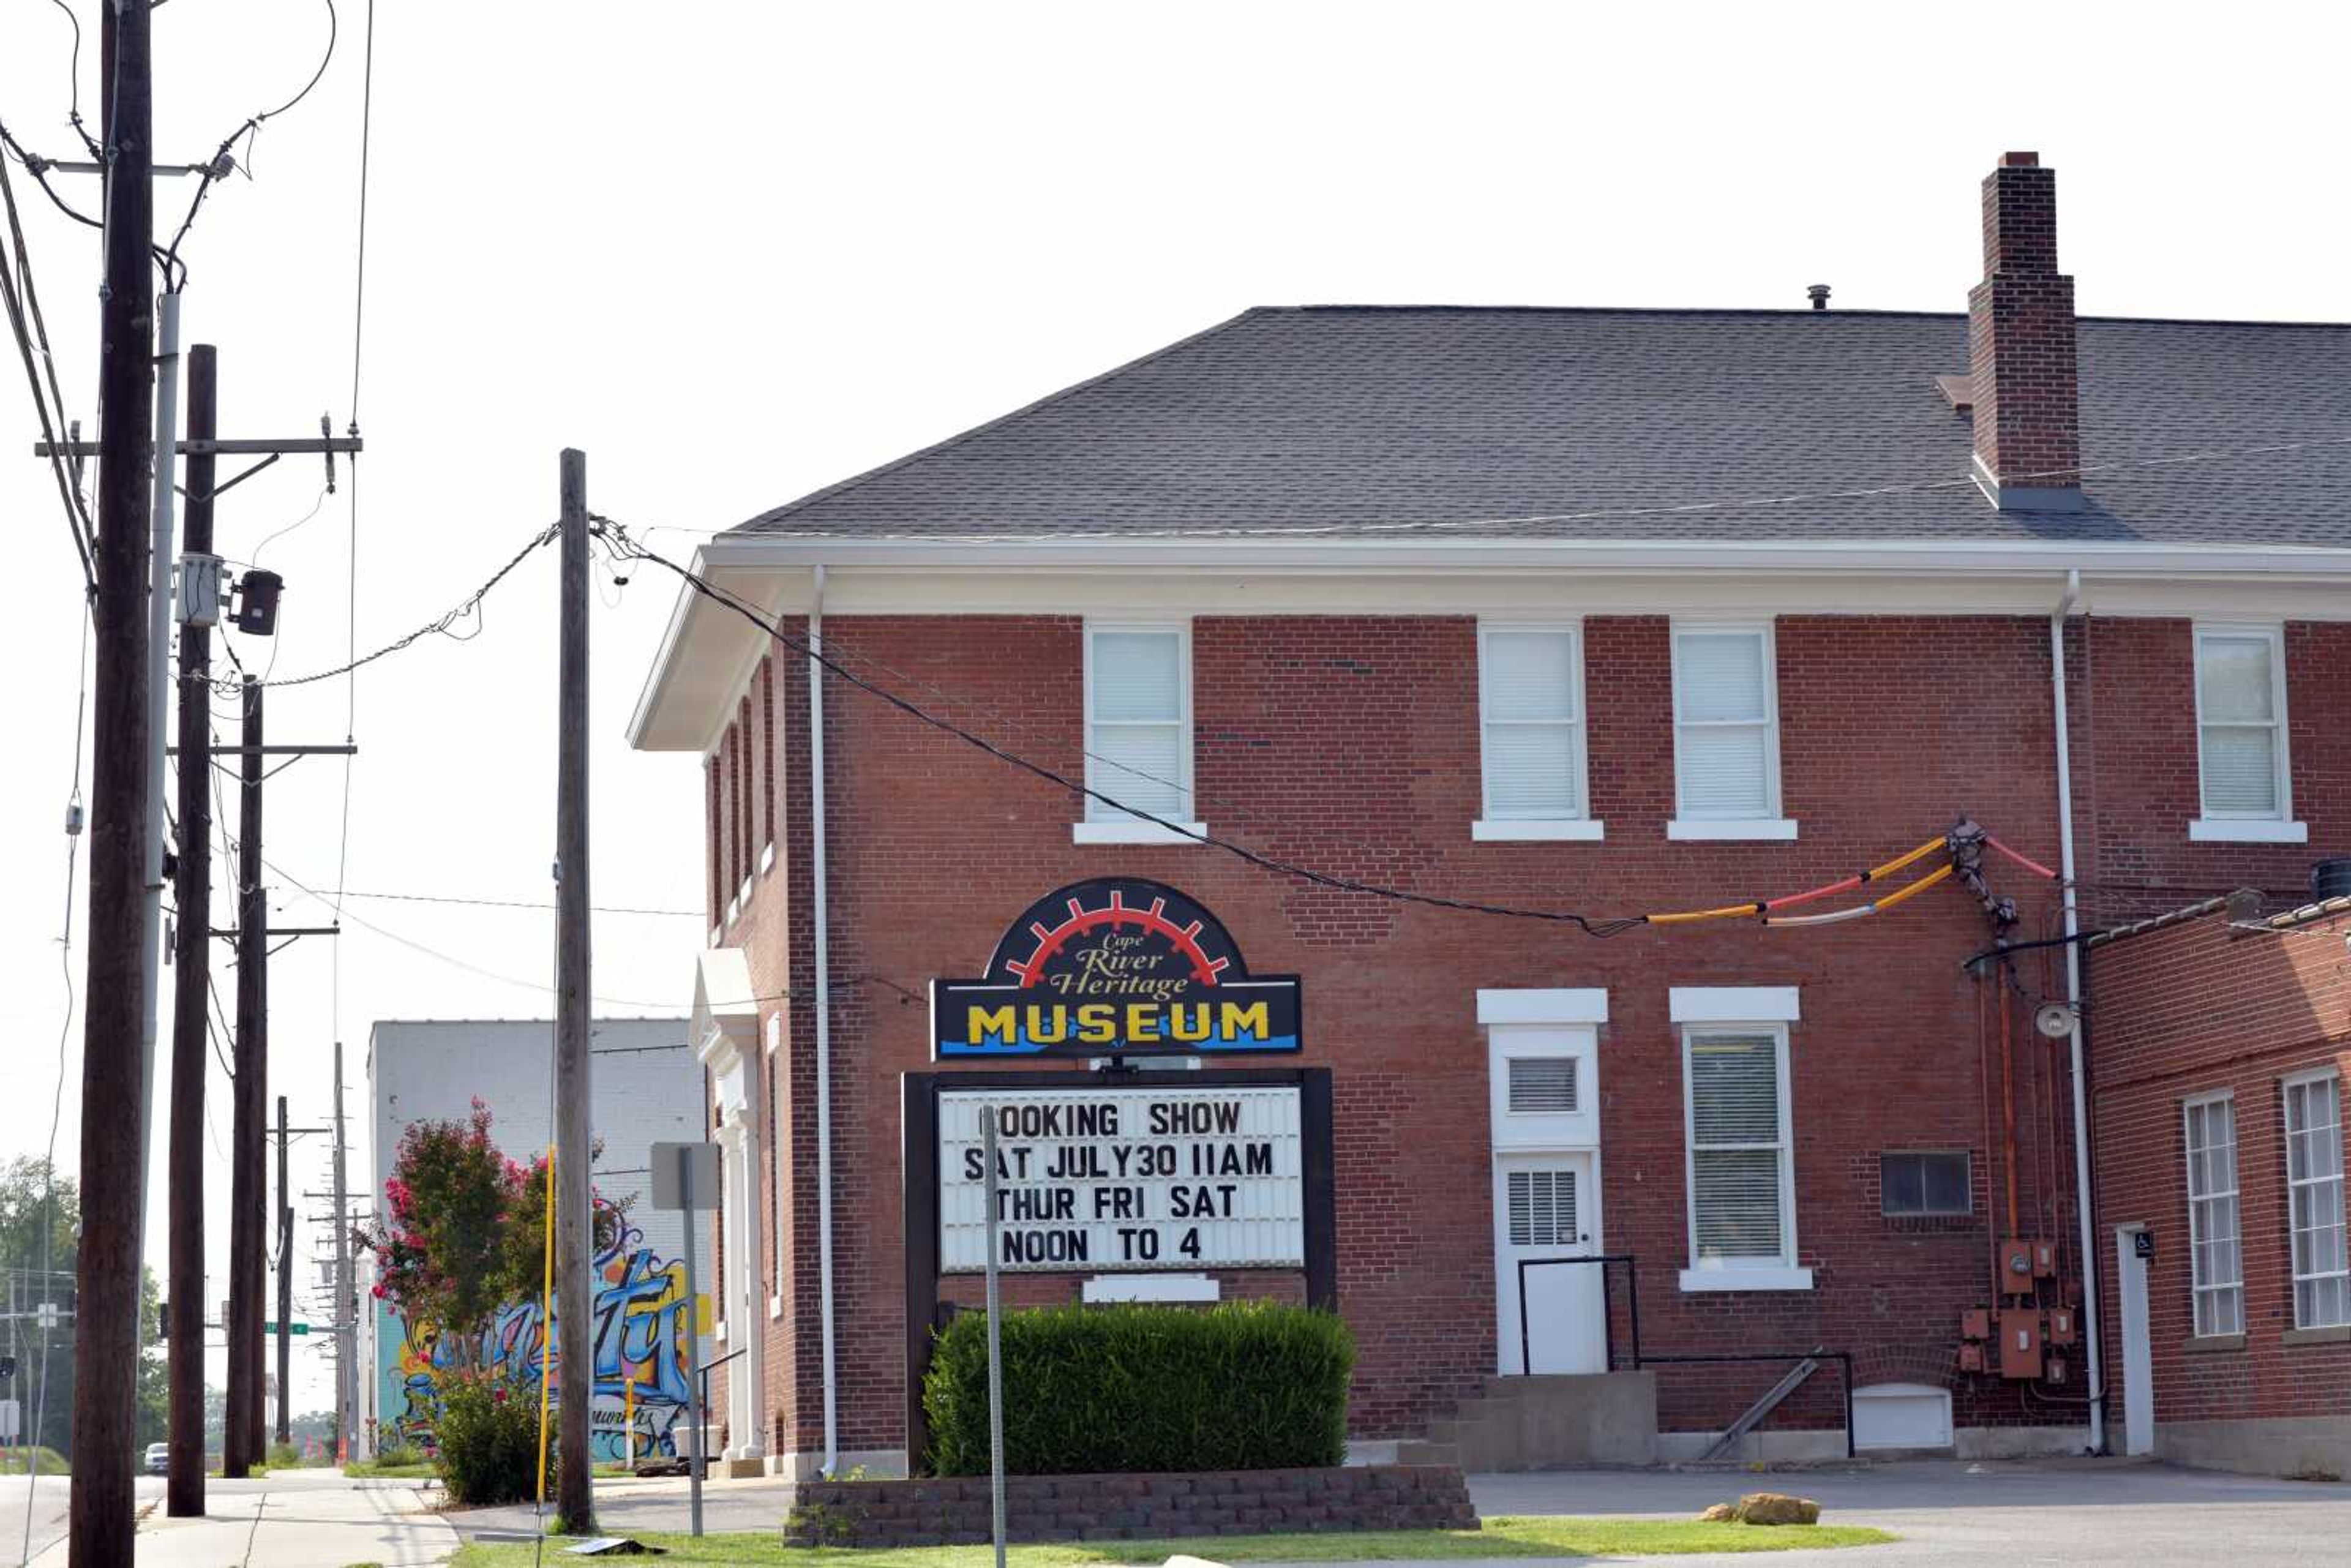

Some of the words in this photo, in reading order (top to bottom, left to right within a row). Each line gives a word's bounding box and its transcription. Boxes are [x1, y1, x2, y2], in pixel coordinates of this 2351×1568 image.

[1104, 932, 1144, 950] Cape
[1076, 948, 1163, 977] River
[1050, 970, 1188, 1001] Heritage
[968, 1002, 1269, 1045] MUSEUM
[1149, 1101, 1241, 1135] SHOW
[997, 1188, 1074, 1220] THUR
[1095, 1187, 1144, 1218] FRI
[1171, 1185, 1237, 1218] SAT
[1003, 1229, 1087, 1262] NOON
[1117, 1228, 1159, 1260] TO
[1179, 1227, 1201, 1259] 4
